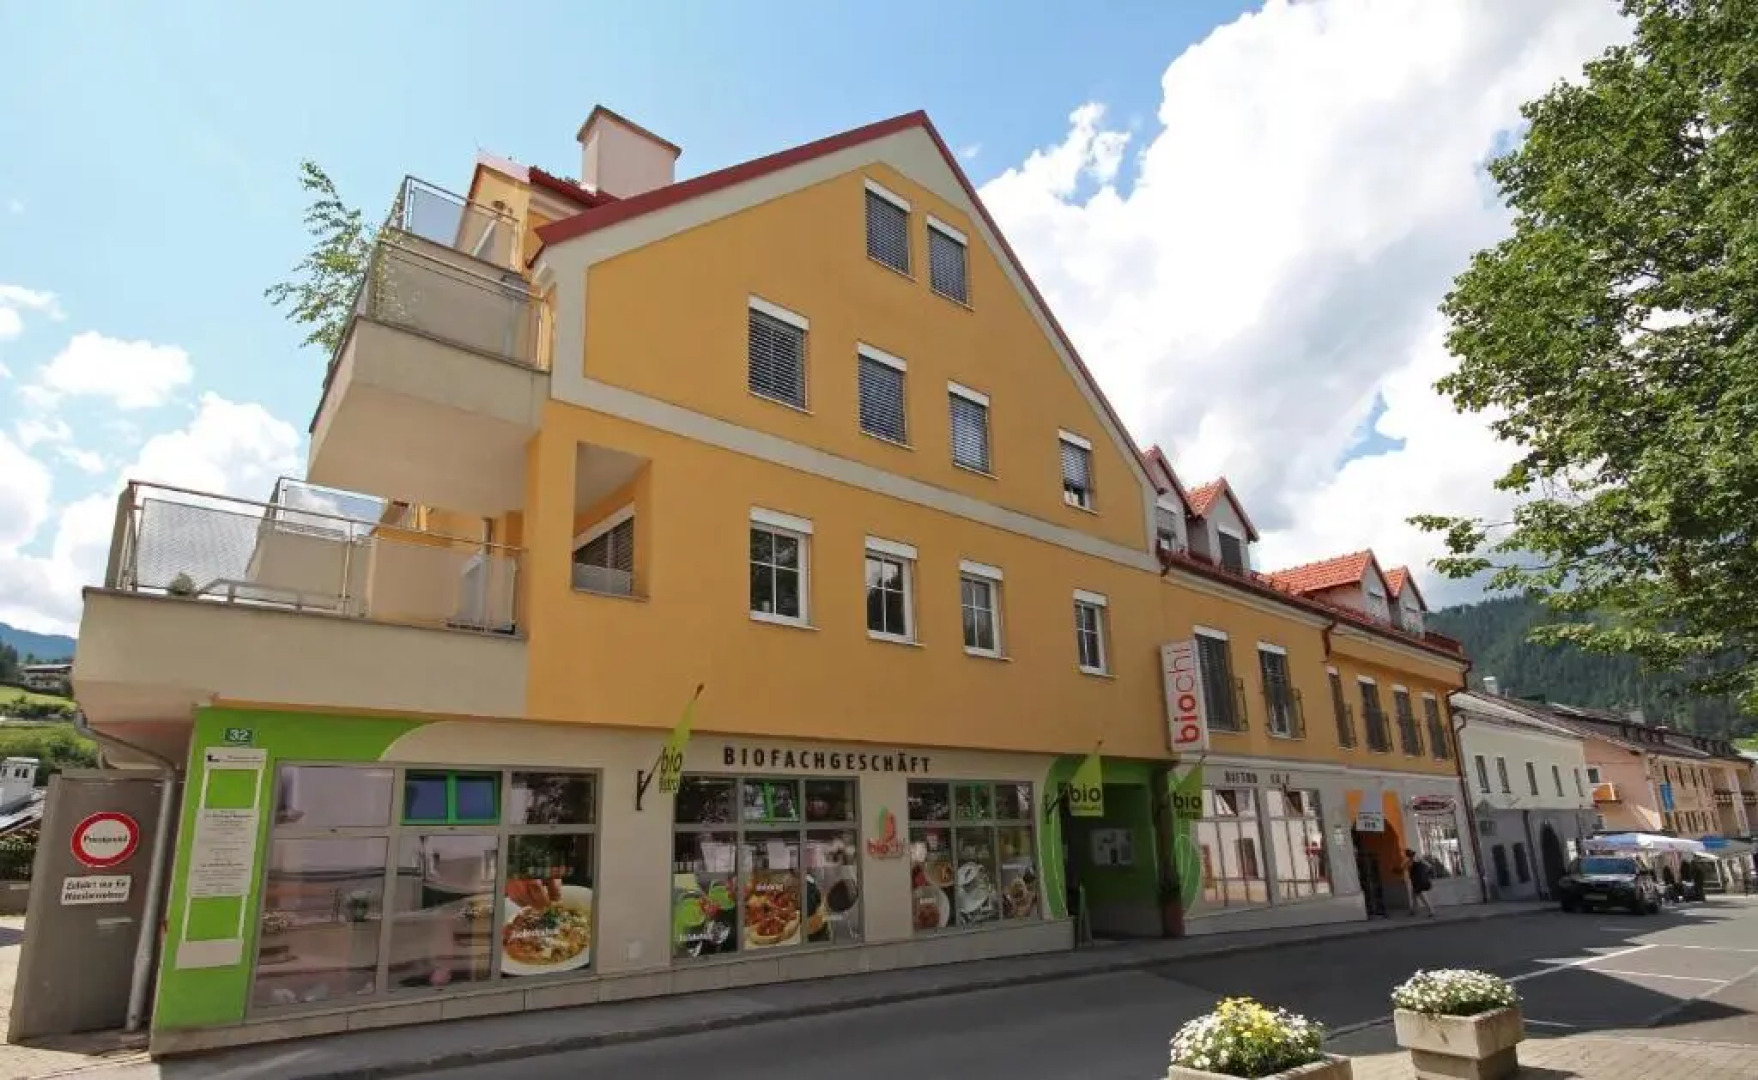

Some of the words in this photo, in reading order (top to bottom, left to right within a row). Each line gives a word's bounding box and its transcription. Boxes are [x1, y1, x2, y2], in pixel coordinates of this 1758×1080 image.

[1166, 647, 1200, 744] biochi
[229, 729, 248, 741] 32
[660, 746, 683, 773] bio
[723, 745, 930, 773] BIOFACHGESCHÄFT
[1069, 783, 1101, 803] bio
[1173, 792, 1203, 810] bio
